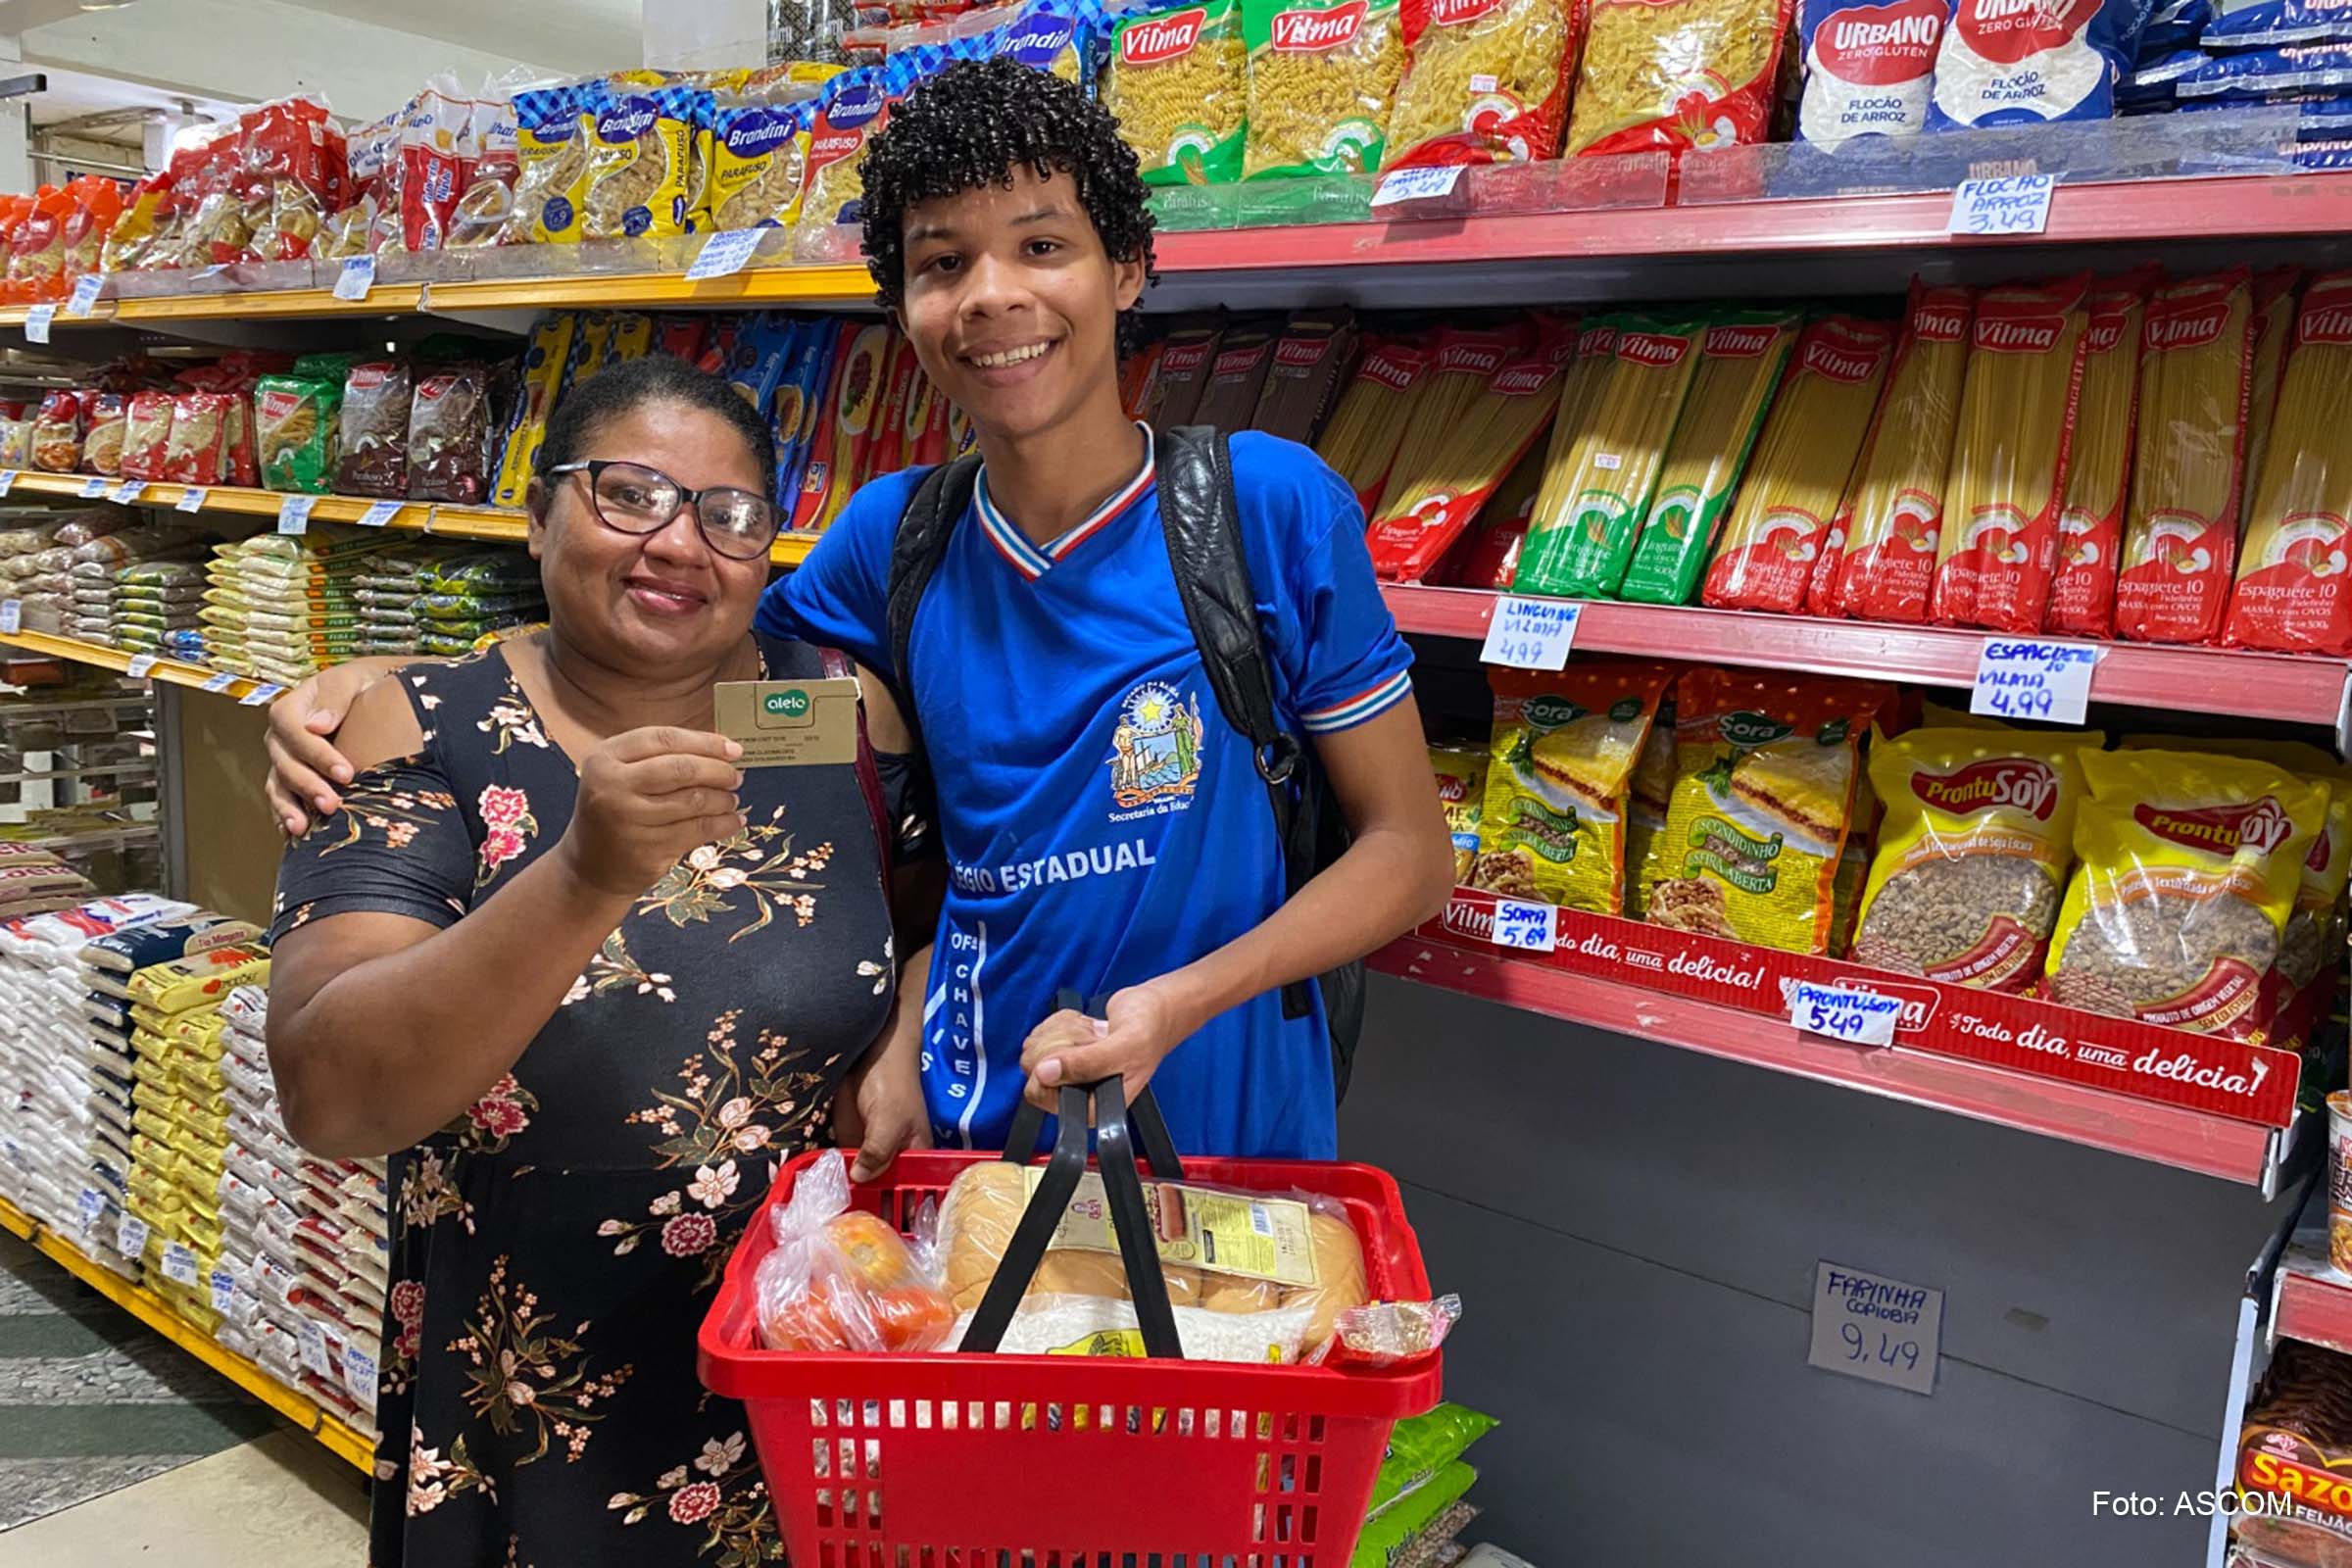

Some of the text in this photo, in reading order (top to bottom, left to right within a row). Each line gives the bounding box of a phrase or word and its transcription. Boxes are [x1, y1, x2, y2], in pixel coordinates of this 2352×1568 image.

[1125, 18, 1194, 57] Vilma
[1835, 15, 1938, 50] URBANO
[1978, 20, 2012, 35] ZERO
[1002, 27, 1072, 53] randin
[1838, 47, 1929, 61] ZERO GLUTEN
[1991, 71, 2039, 89] FLOCÃO
[1982, 84, 2046, 100] DE ARROZ
[1848, 98, 1903, 110] FLOCÃO
[1840, 112, 1906, 123] DE ARROZ
[728, 119, 793, 147] Brandini
[720, 160, 767, 180] PARAFUSO
[1707, 327, 1767, 352] Vilma
[1976, 318, 2054, 346] Vilma
[1619, 335, 1679, 362] Vilma
[1368, 355, 1413, 386] ilma
[1805, 344, 1870, 378] Vilma
[1789, 565, 1806, 580] 10
[1917, 559, 1934, 574] 10
[2004, 570, 2022, 585] 10
[2075, 571, 2092, 586] 10
[2185, 579, 2204, 596] 10
[2237, 582, 2337, 601] Espaguete 10
[1506, 601, 1578, 621] LINGUINE
[2241, 605, 2275, 614] MASSA
[2301, 607, 2331, 616] OVOS
[767, 697, 806, 710] alelo
[1520, 699, 1574, 720] Sora
[1718, 712, 1776, 738] Sora
[1926, 767, 2056, 816] ProntuSoy
[1108, 806, 1156, 823] Secretaria
[1156, 804, 1169, 814] da
[1692, 819, 1779, 858] ESCONDIDINHO
[2151, 809, 2286, 856] Prontuoy
[954, 838, 1156, 893] ÉGIO ESTADUAL
[1725, 868, 1773, 892] ABERTA
[1445, 902, 1494, 932] Vilm
[1498, 903, 1546, 925] SORA
[1556, 934, 1576, 950] do
[1625, 950, 1663, 968] uma
[1667, 952, 1766, 991] delícia!
[1796, 985, 1900, 1014] PRONTUSOY
[2180, 1006, 2192, 1019] DE
[2190, 996, 2219, 1016] ORIGEM
[2197, 1013, 2218, 1030] SEM
[1960, 1014, 2013, 1043] Todo
[2077, 1044, 2127, 1068] uma
[2132, 1048, 2270, 1097] delícia!
[1827, 1271, 1928, 1310] FARINHA
[1845, 1297, 1920, 1325] COPIOBA
